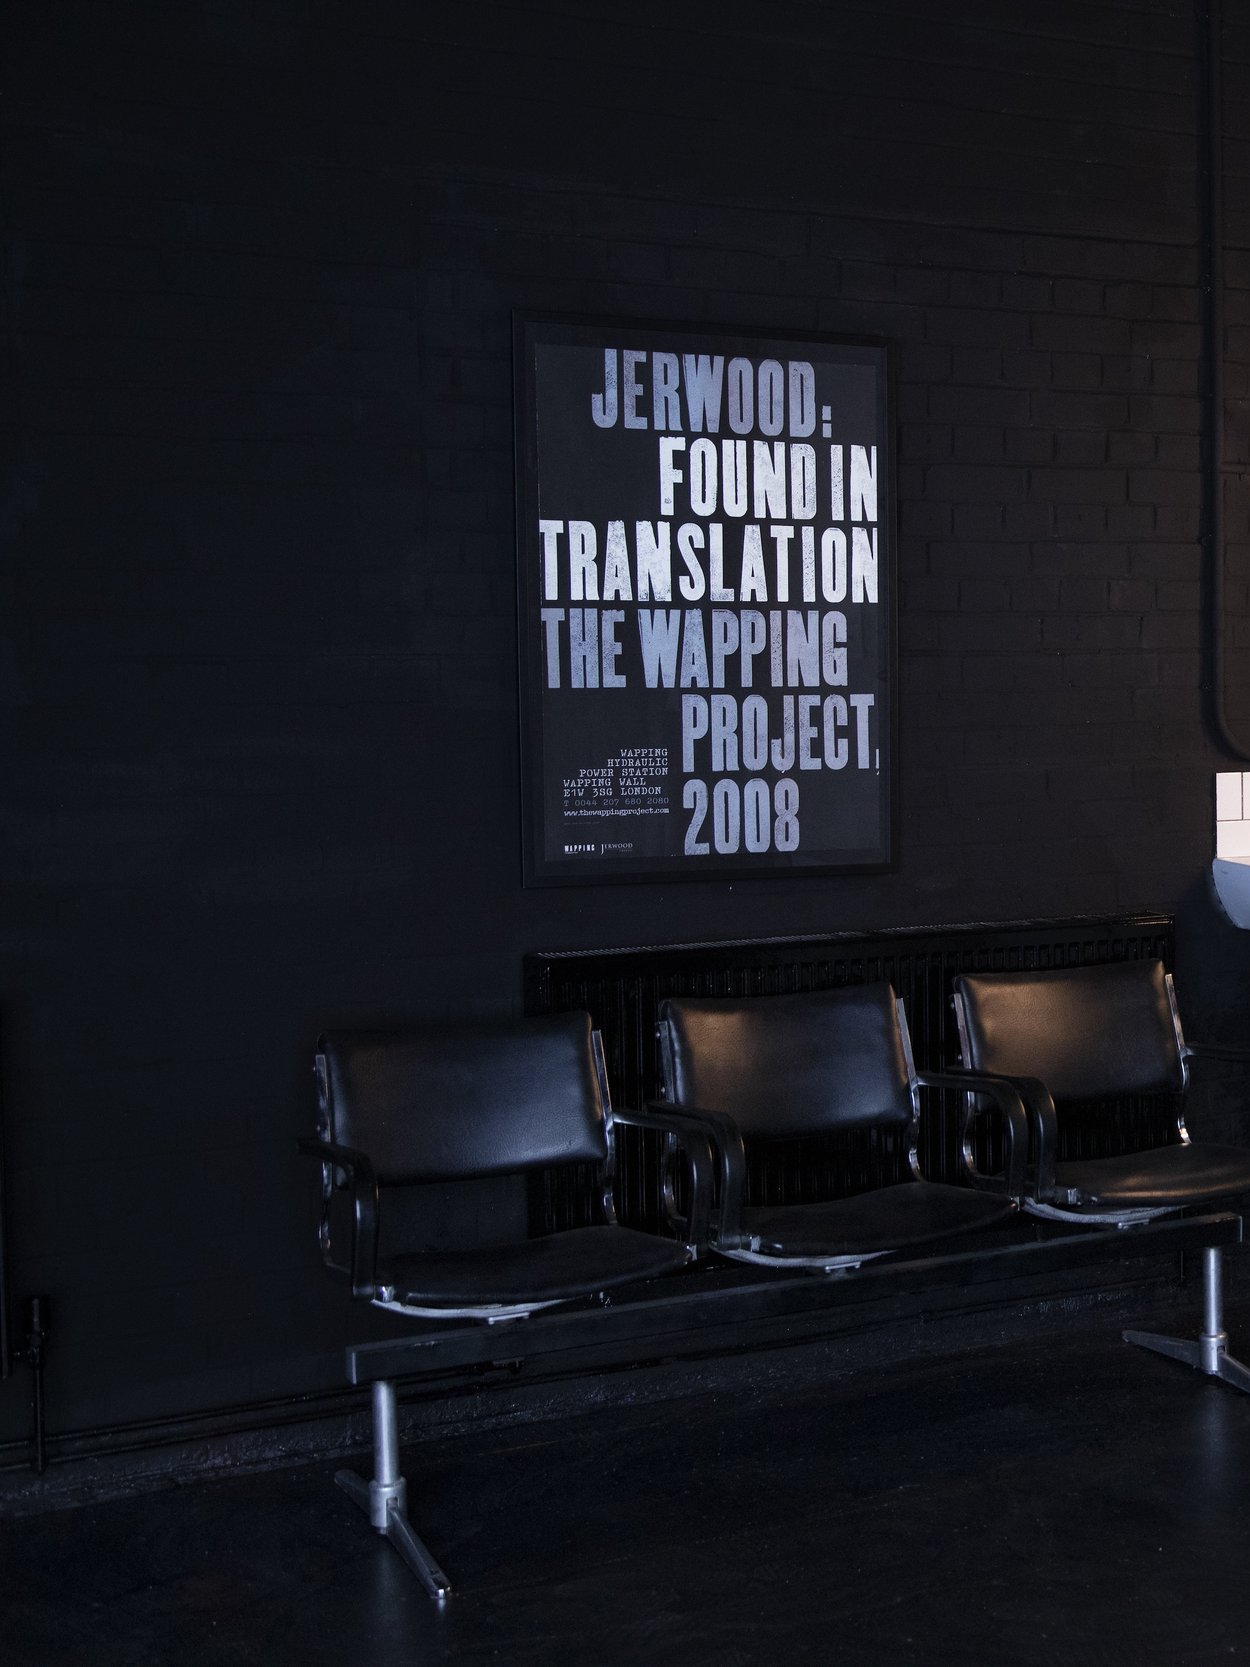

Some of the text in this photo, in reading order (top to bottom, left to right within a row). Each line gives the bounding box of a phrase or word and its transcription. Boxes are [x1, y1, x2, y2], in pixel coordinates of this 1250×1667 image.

[592, 348, 832, 439] JERWOOD:
[659, 436, 877, 522] FOUND IN
[539, 519, 878, 604] TRANSLATION
[541, 608, 848, 688] THE WAPPING
[621, 749, 668, 757] WAPPING
[608, 758, 668, 767] HYDRAULIC
[580, 768, 668, 777] POWER STATION
[563, 778, 646, 787] WAPPING WALL
[564, 787, 661, 798] E1W 3SG LONDON
[564, 808, 669, 817] www.thewappingproject.com
[683, 778, 799, 855] 2008
[564, 844, 595, 852] WAPPING
